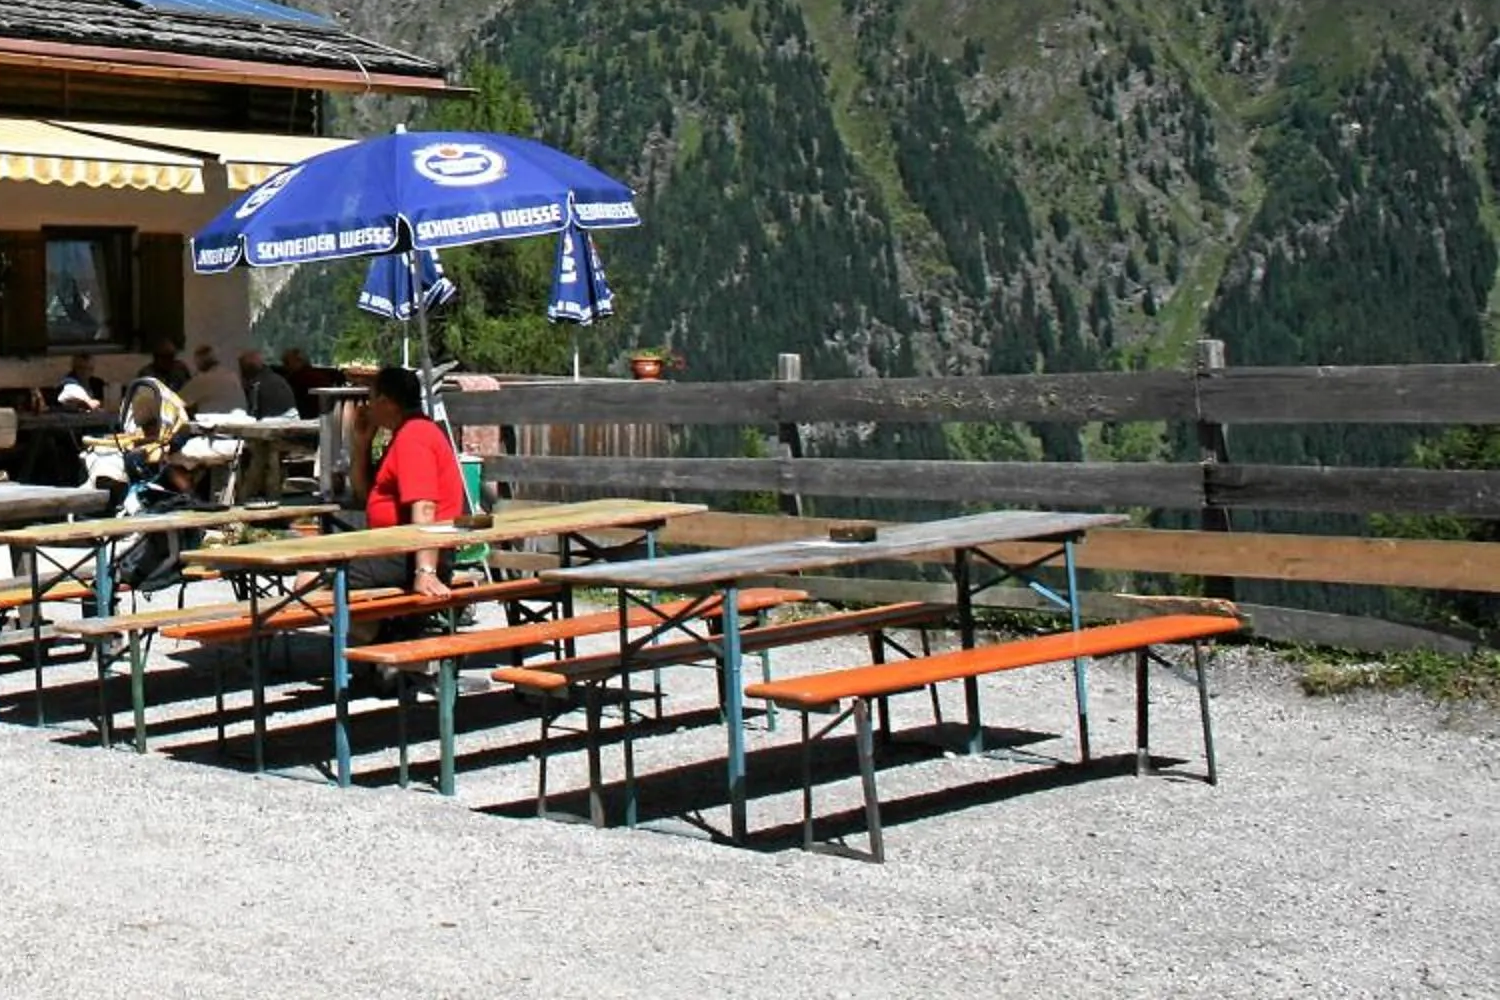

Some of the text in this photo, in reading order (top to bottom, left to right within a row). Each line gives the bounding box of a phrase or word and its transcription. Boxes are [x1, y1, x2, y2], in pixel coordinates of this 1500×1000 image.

[417, 212, 500, 240] SCHNEIDER
[501, 203, 562, 229] WEISSE
[256, 232, 337, 260] SCHNEIDER
[339, 226, 393, 249] WEISSE
